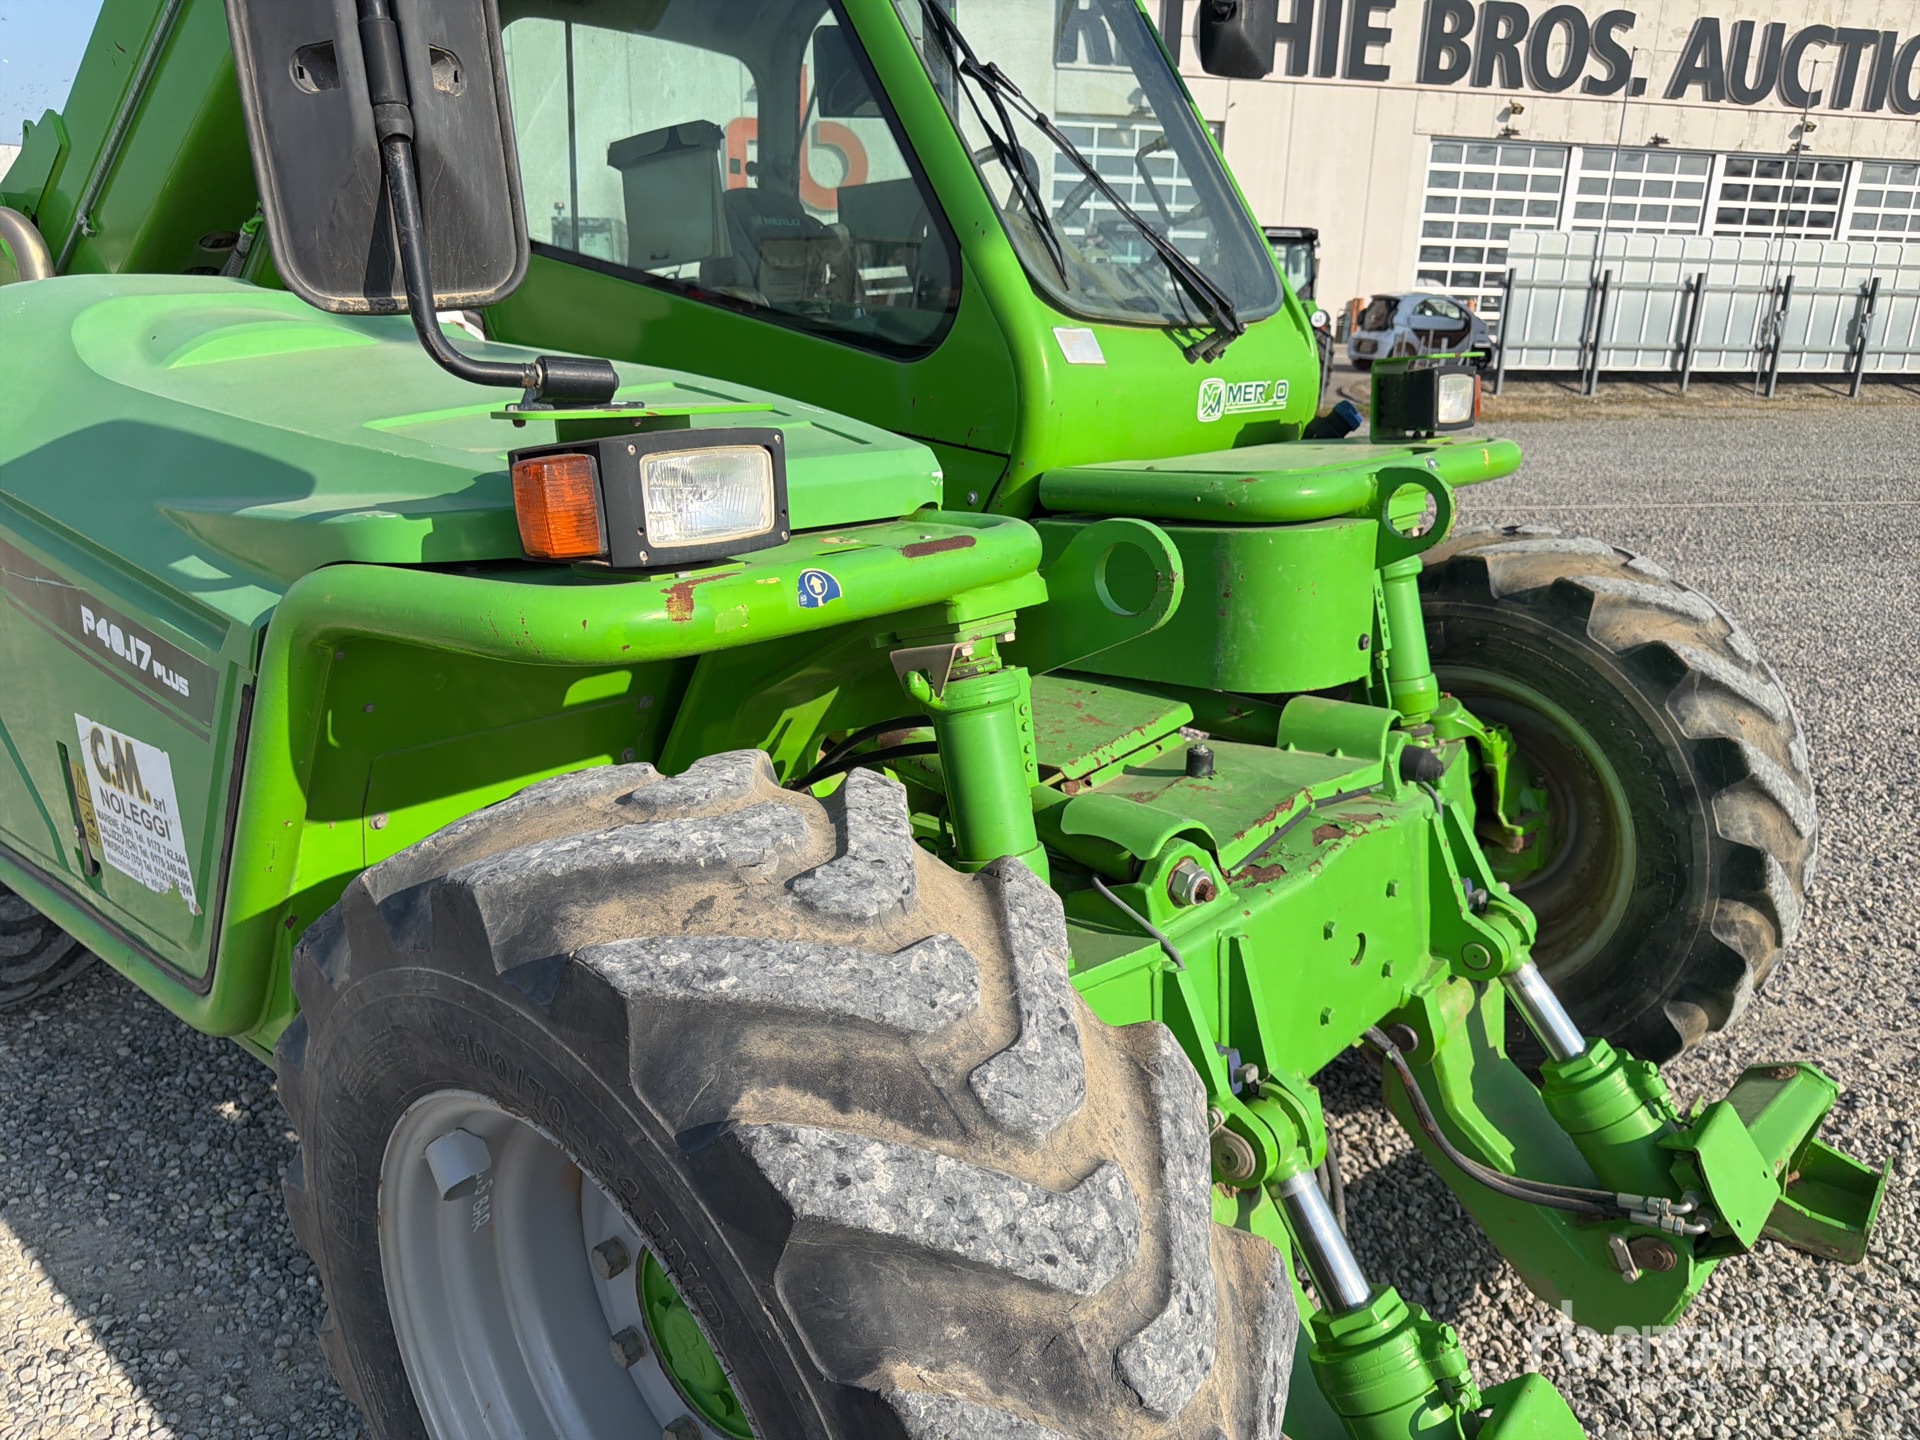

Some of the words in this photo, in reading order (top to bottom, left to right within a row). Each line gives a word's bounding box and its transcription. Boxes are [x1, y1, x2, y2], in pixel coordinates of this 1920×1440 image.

[1053, 0, 1396, 82] RHIE
[1416, 0, 1647, 96] BROS.
[1226, 381, 1288, 405] MERO
[80, 604, 152, 672] P40.17
[152, 659, 190, 698] PLUS
[89, 726, 151, 806] C.M.
[153, 798, 167, 815] srl
[99, 785, 171, 841] NOLEGGI
[471, 1194, 491, 1234] BAR
